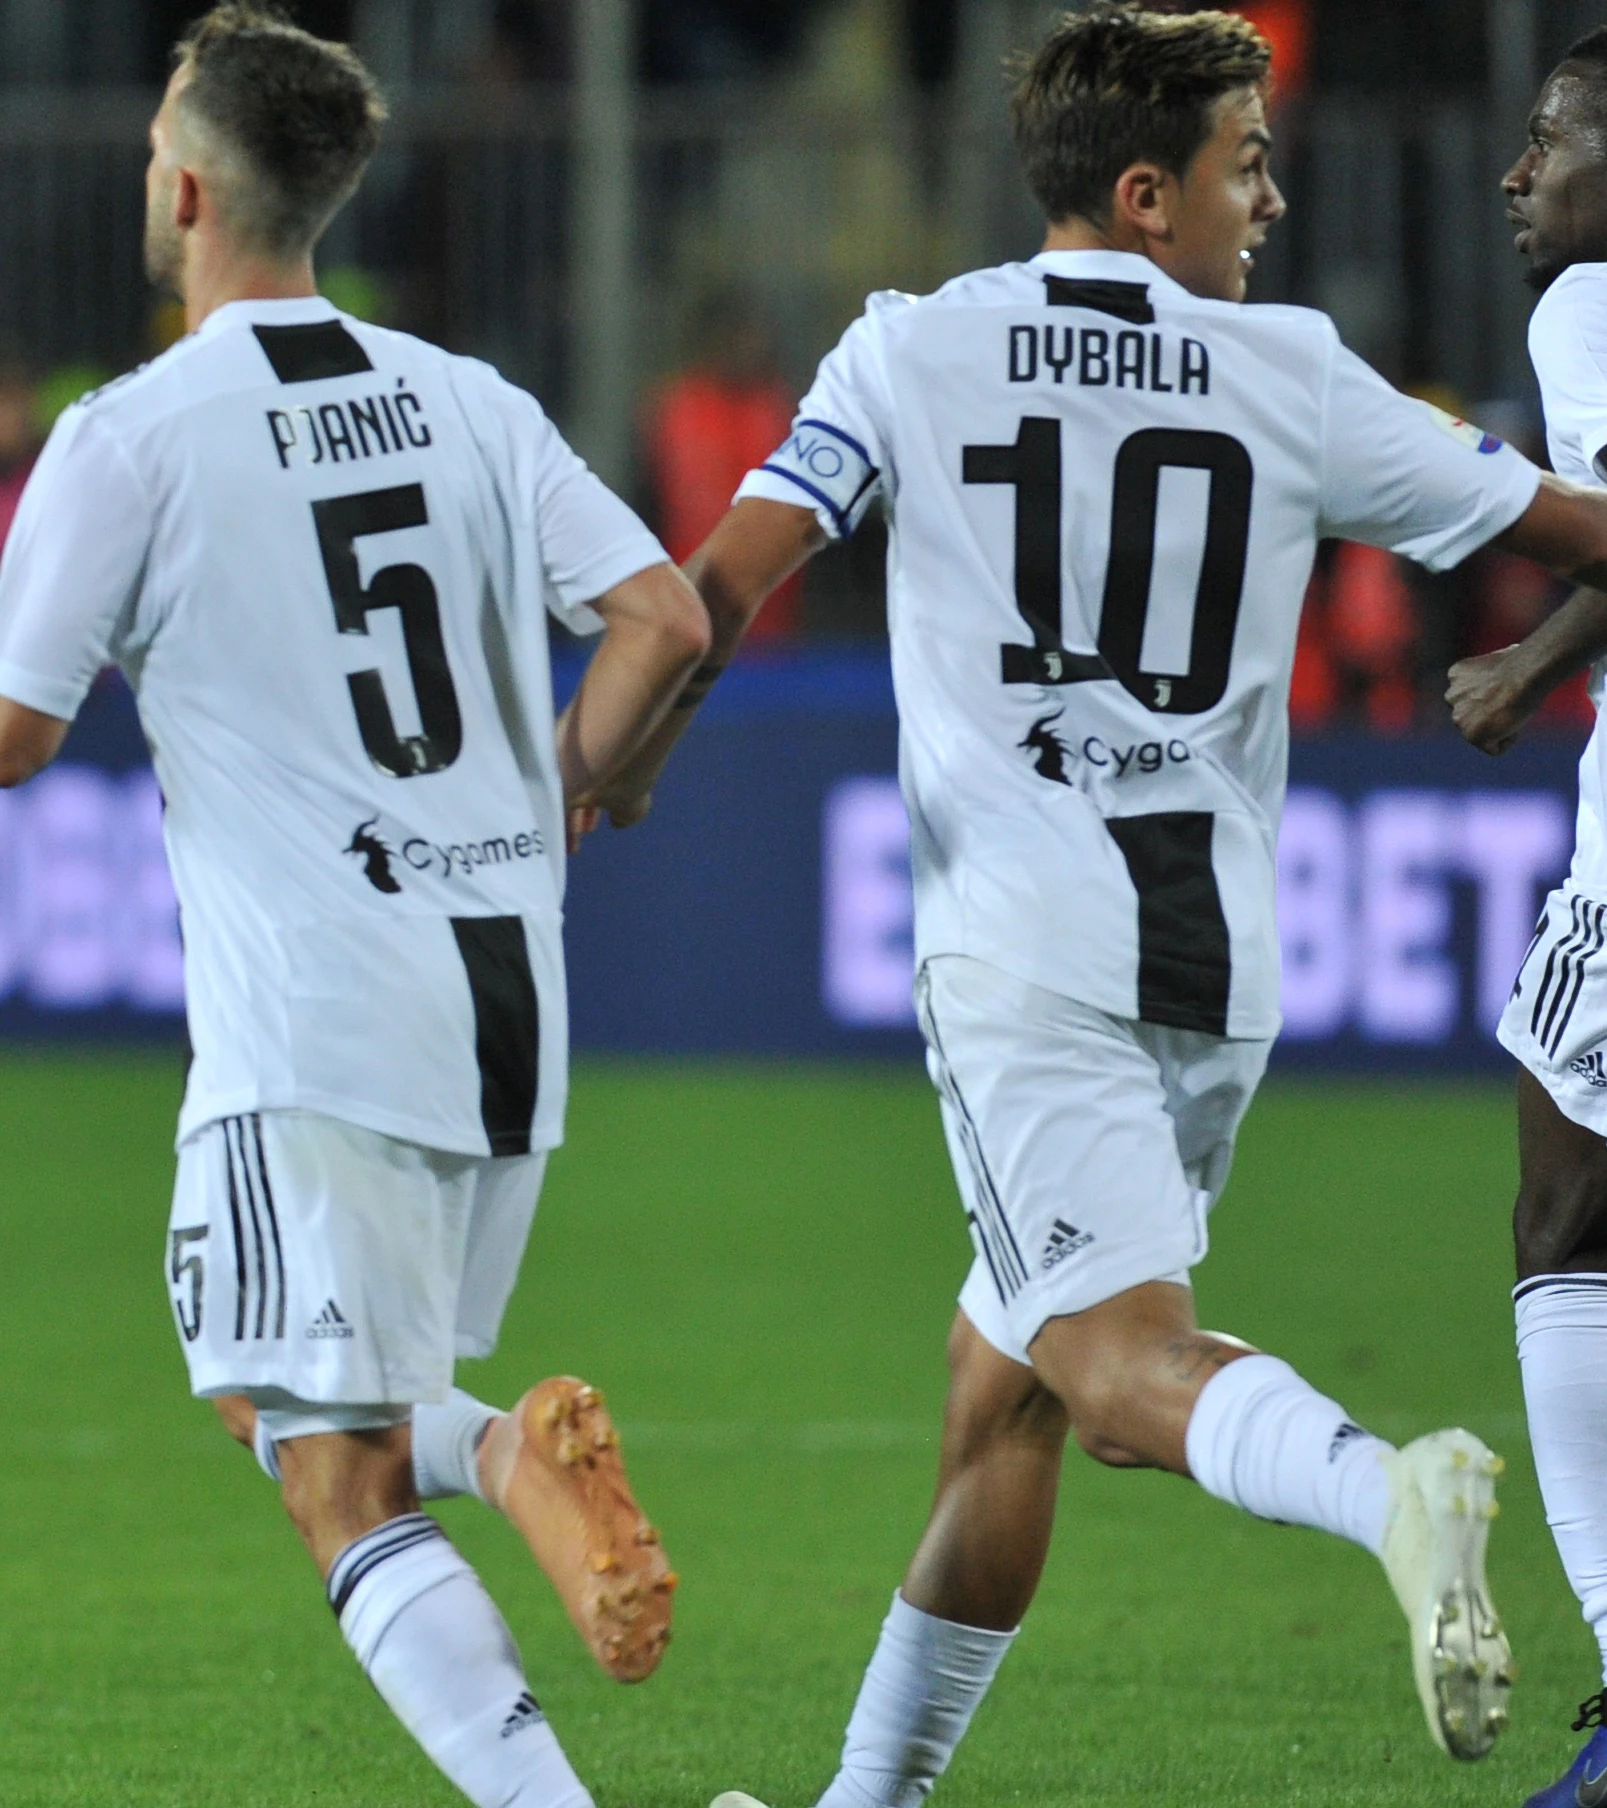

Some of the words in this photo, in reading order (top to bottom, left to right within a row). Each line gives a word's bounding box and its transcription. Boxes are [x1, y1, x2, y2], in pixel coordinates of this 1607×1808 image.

[1008, 324, 1210, 396] DYBALA
[266, 377, 432, 469] PJANIĆ
[961, 415, 1254, 714] 10
[310, 482, 464, 780] 5
[171, 1224, 210, 1342] 5
